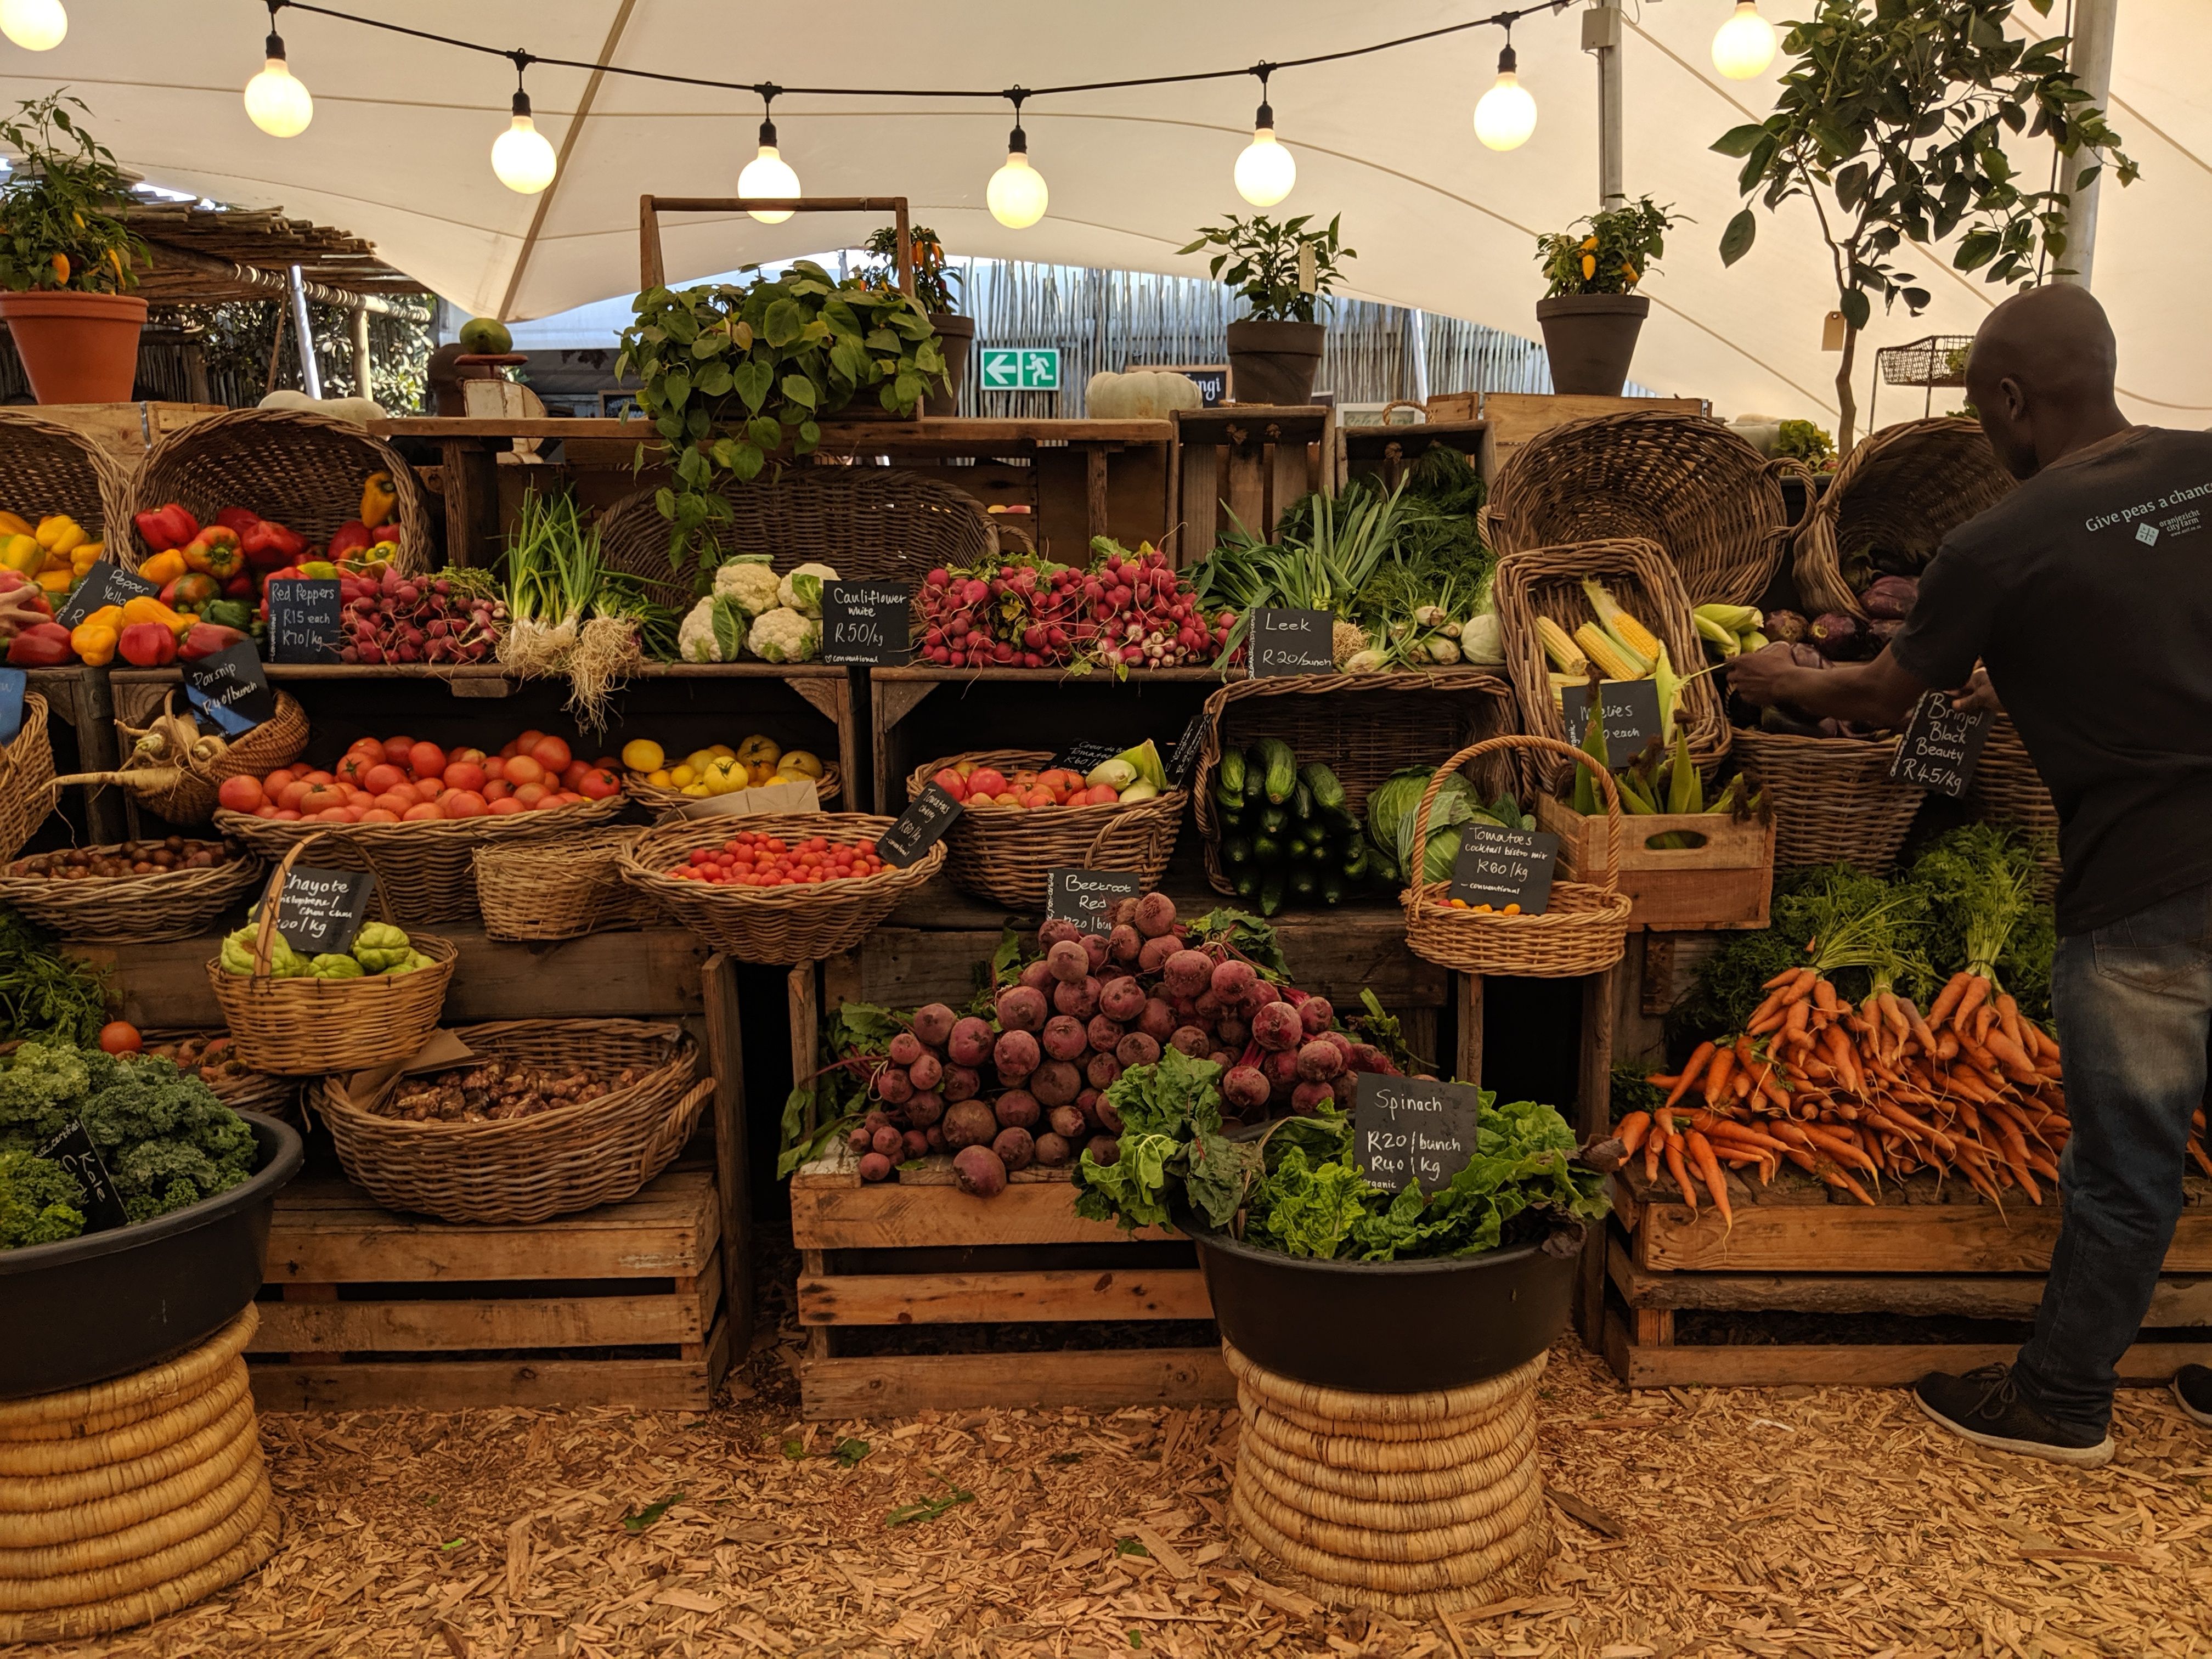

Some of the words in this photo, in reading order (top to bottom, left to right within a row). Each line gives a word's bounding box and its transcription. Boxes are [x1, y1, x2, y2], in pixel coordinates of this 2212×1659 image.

[2085, 513, 2120, 532] Give
[2121, 501, 2156, 522] peas
[2158, 498, 2169, 508] a
[2169, 483, 2212, 504] chanc
[2159, 510, 2200, 527] oranjezicht
[2166, 523, 2180, 532] city
[2181, 517, 2199, 527] farm
[109, 569, 149, 594] Pepper
[272, 583, 291, 603] Red
[296, 583, 335, 606] Peppers
[834, 588, 907, 606] Cauliflower
[283, 608, 304, 627] R15
[307, 613, 330, 624] each
[1265, 613, 1311, 632] Leek
[193, 663, 236, 690] Parsnip
[1580, 705, 1633, 721] Melies
[1928, 692, 1983, 732] Brinjal
[1612, 727, 1640, 738] each
[1929, 720, 1966, 744] Black
[1916, 737, 1964, 766] Beauty
[1063, 756, 1101, 767] R60/k
[923, 788, 950, 815] Tomatoes
[1469, 826, 1532, 845] Tomatoes
[1465, 843, 1501, 854] cocktail
[1504, 847, 1528, 857] bistro
[1531, 851, 1548, 860] mix
[1066, 874, 1131, 893] Beetroot
[1079, 895, 1107, 910] Red
[1374, 1088, 1442, 1121] Spinach
[78, 1151, 106, 1203] Kale
